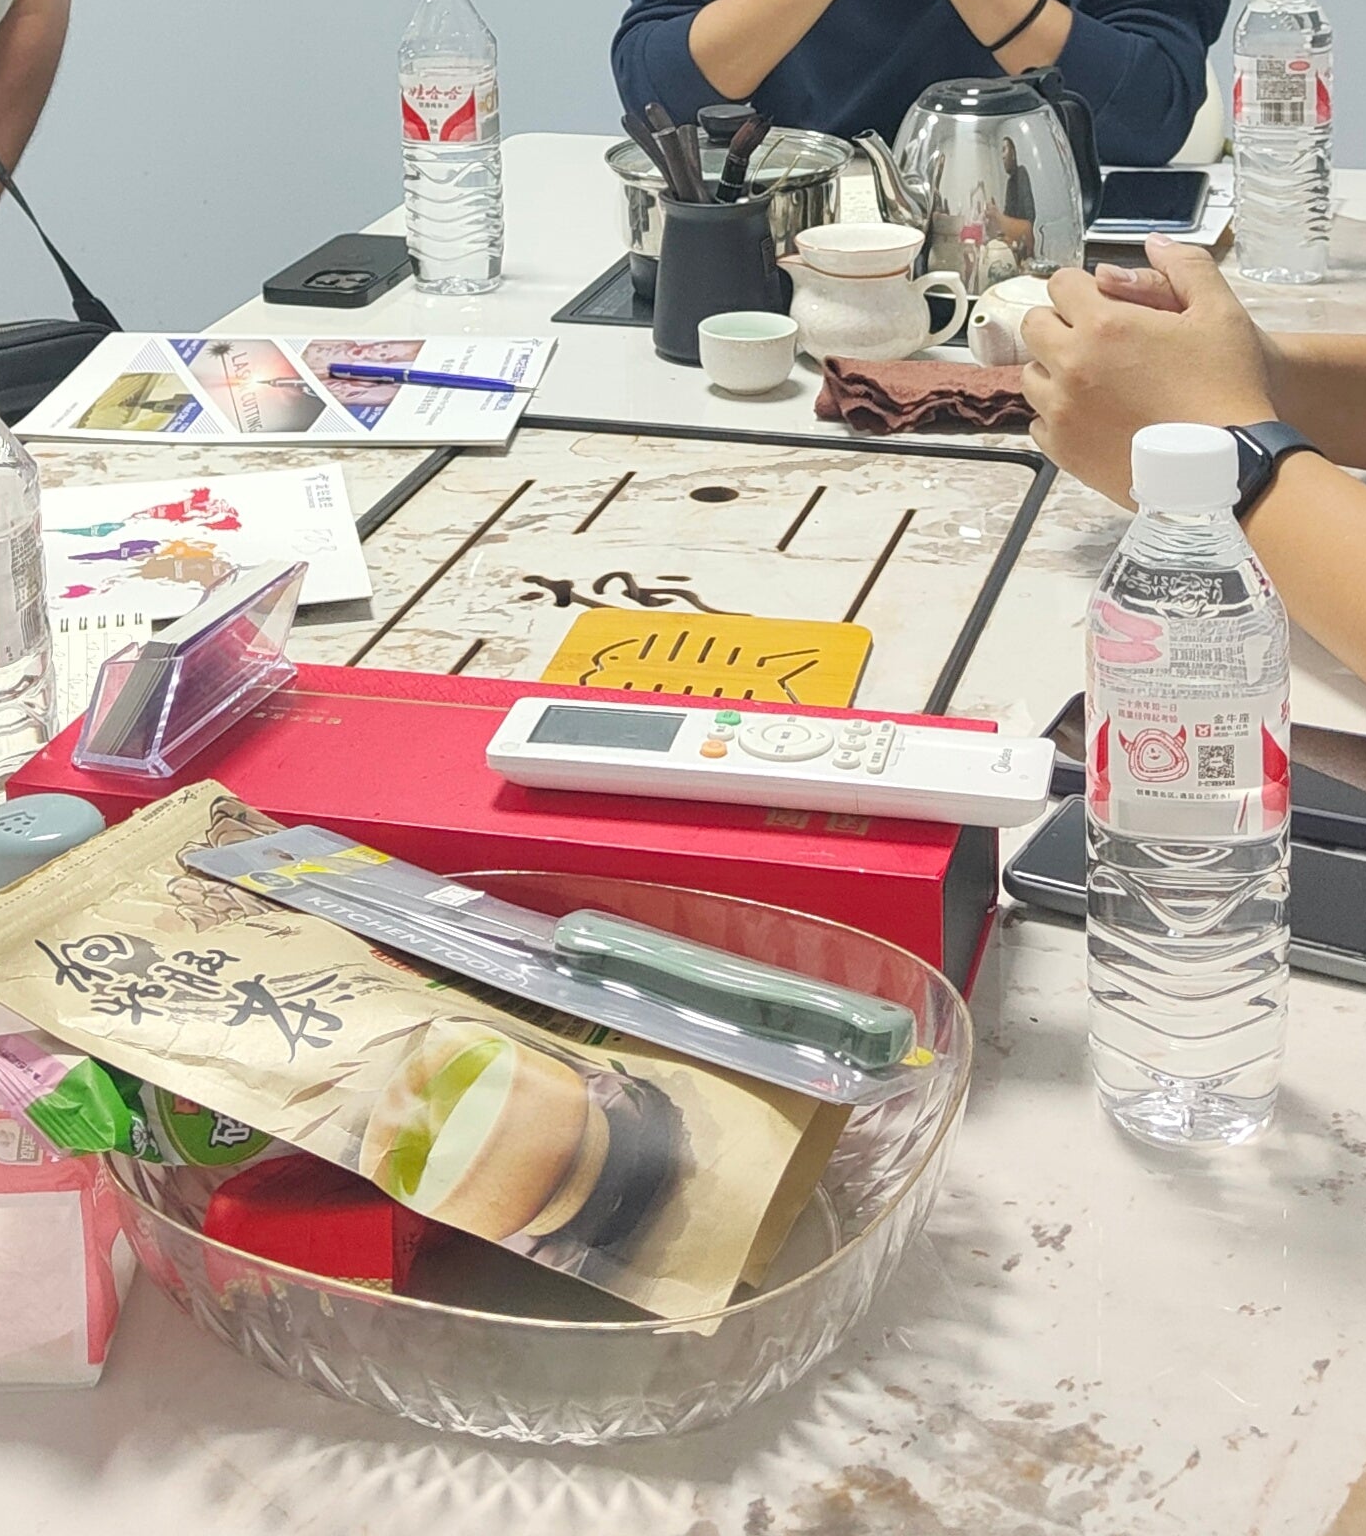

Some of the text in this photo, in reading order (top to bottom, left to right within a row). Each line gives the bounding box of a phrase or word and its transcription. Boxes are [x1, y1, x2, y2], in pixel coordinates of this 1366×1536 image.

[1213, 713, 1250, 724] 金牛座
[304, 895, 427, 946] KITCHEN
[430, 943, 517, 982] TOOLS
